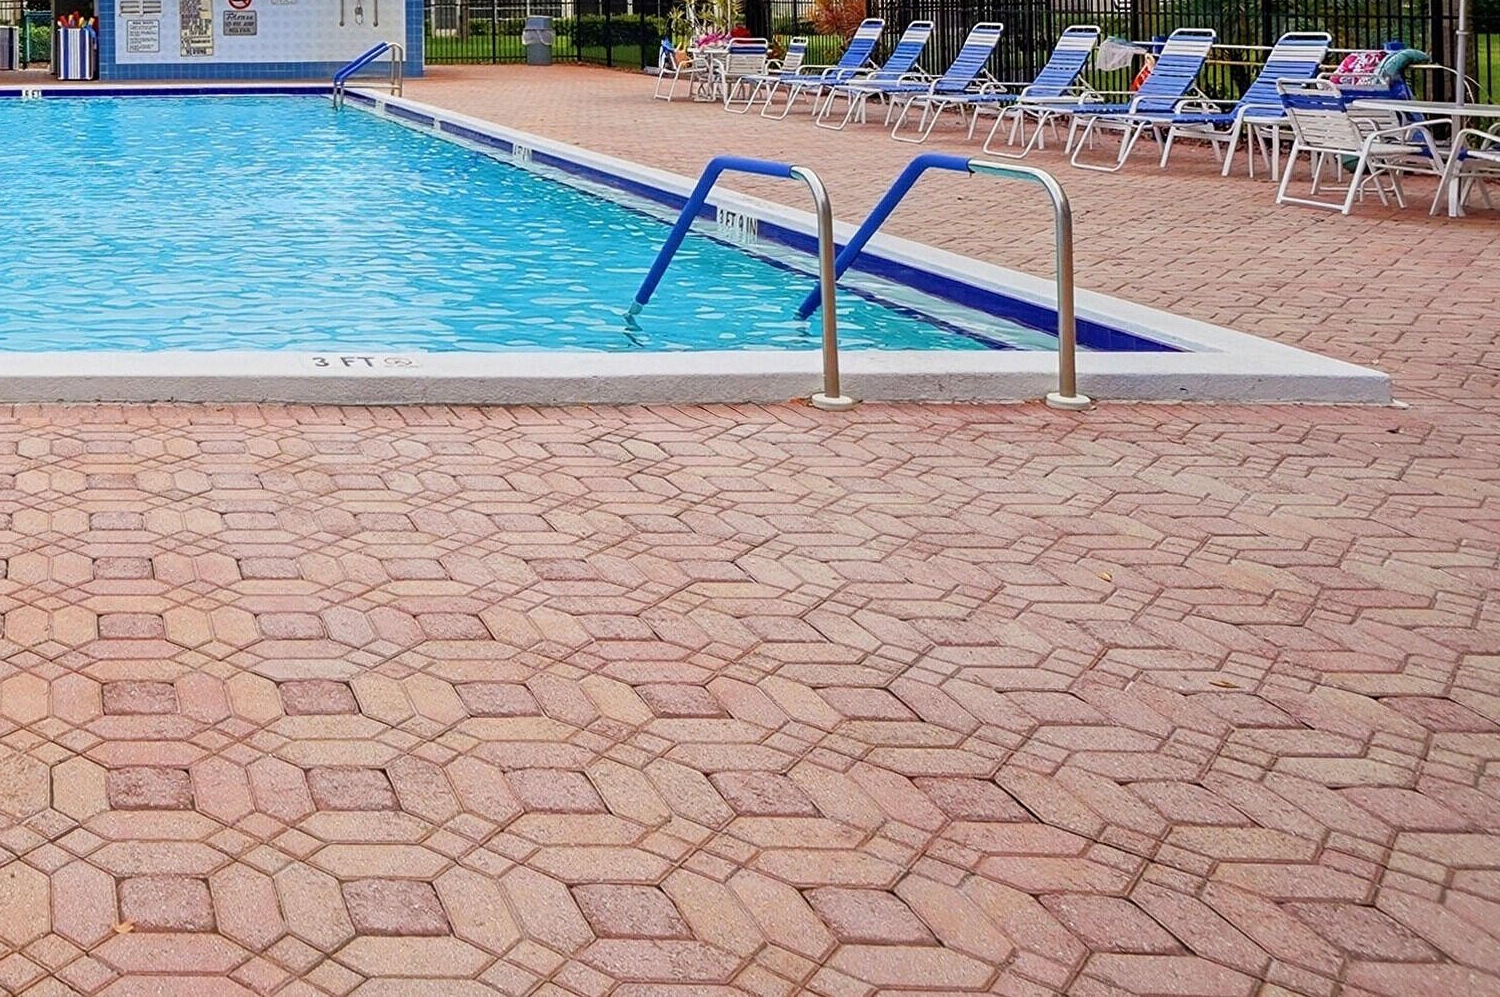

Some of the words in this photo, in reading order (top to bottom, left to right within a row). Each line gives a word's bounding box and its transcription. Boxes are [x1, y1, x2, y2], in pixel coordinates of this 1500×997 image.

[725, 211, 736, 227] FT
[746, 216, 757, 236] IN
[312, 356, 330, 367] 3
[340, 356, 376, 367] FT
